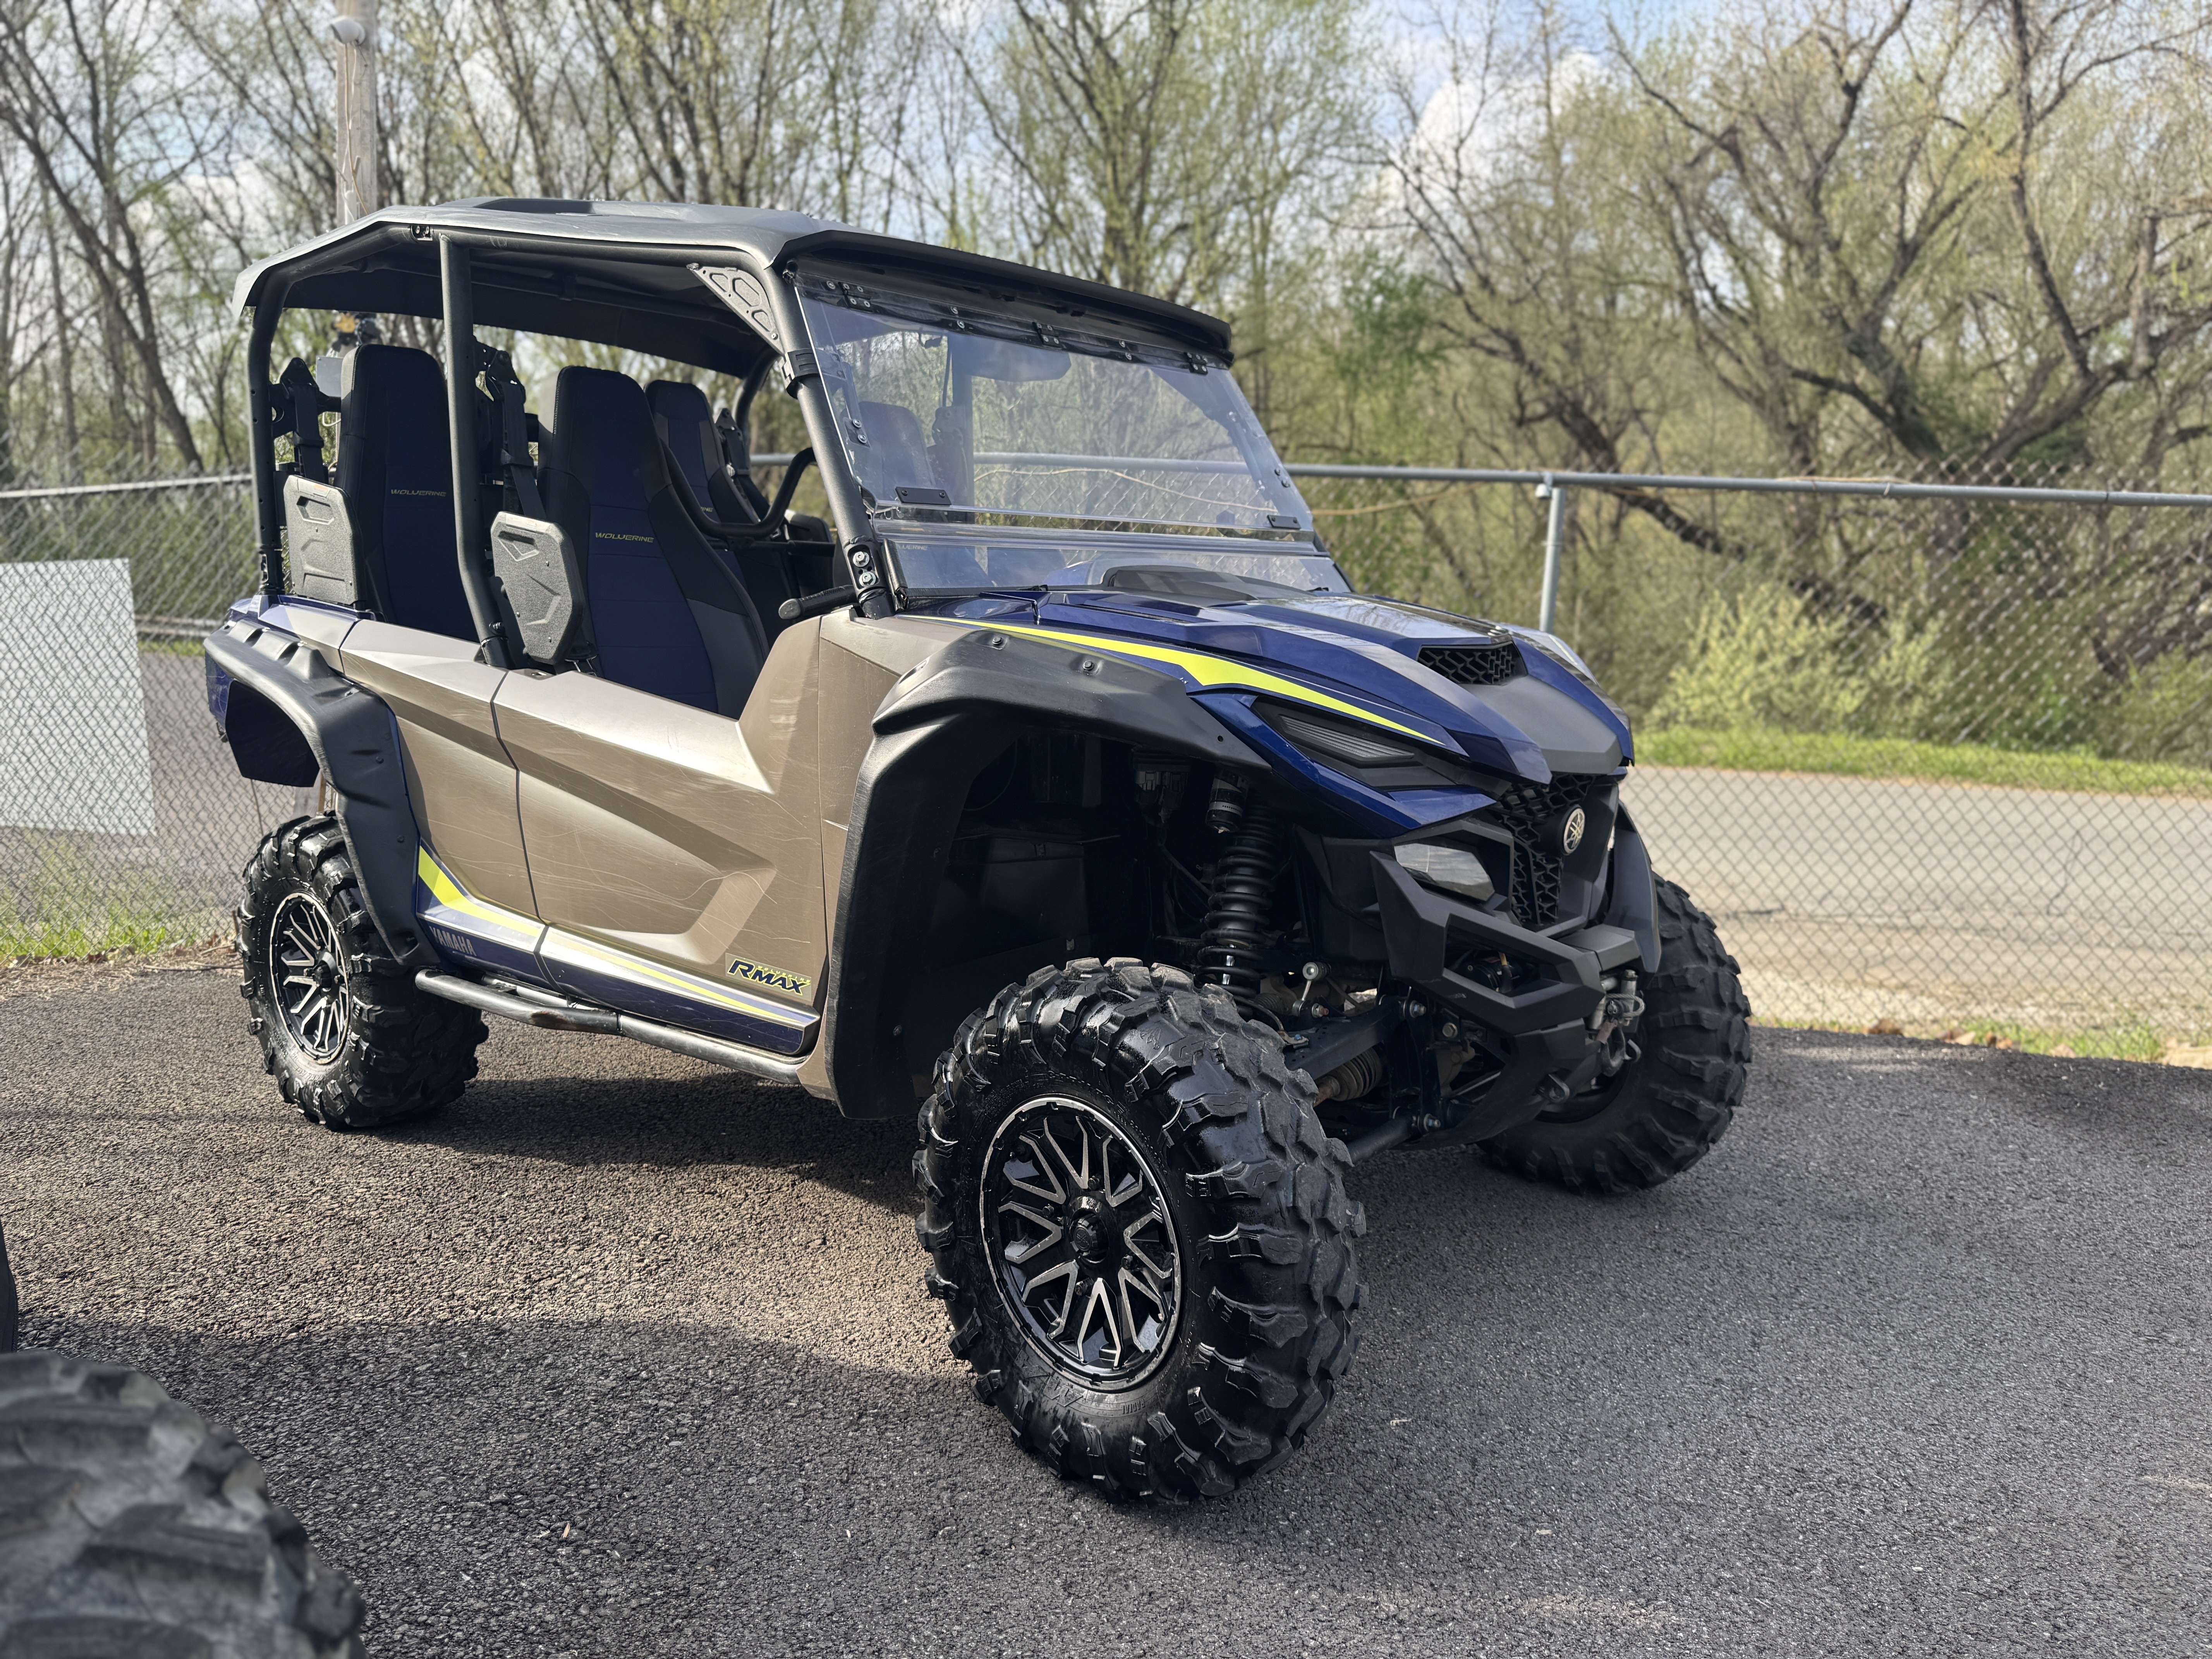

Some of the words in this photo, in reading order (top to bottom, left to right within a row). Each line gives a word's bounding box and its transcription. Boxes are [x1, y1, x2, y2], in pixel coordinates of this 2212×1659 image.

[595, 532, 654, 543] WOLVERINE
[429, 926, 477, 957] YAMAHA
[727, 958, 811, 996] RMAX
